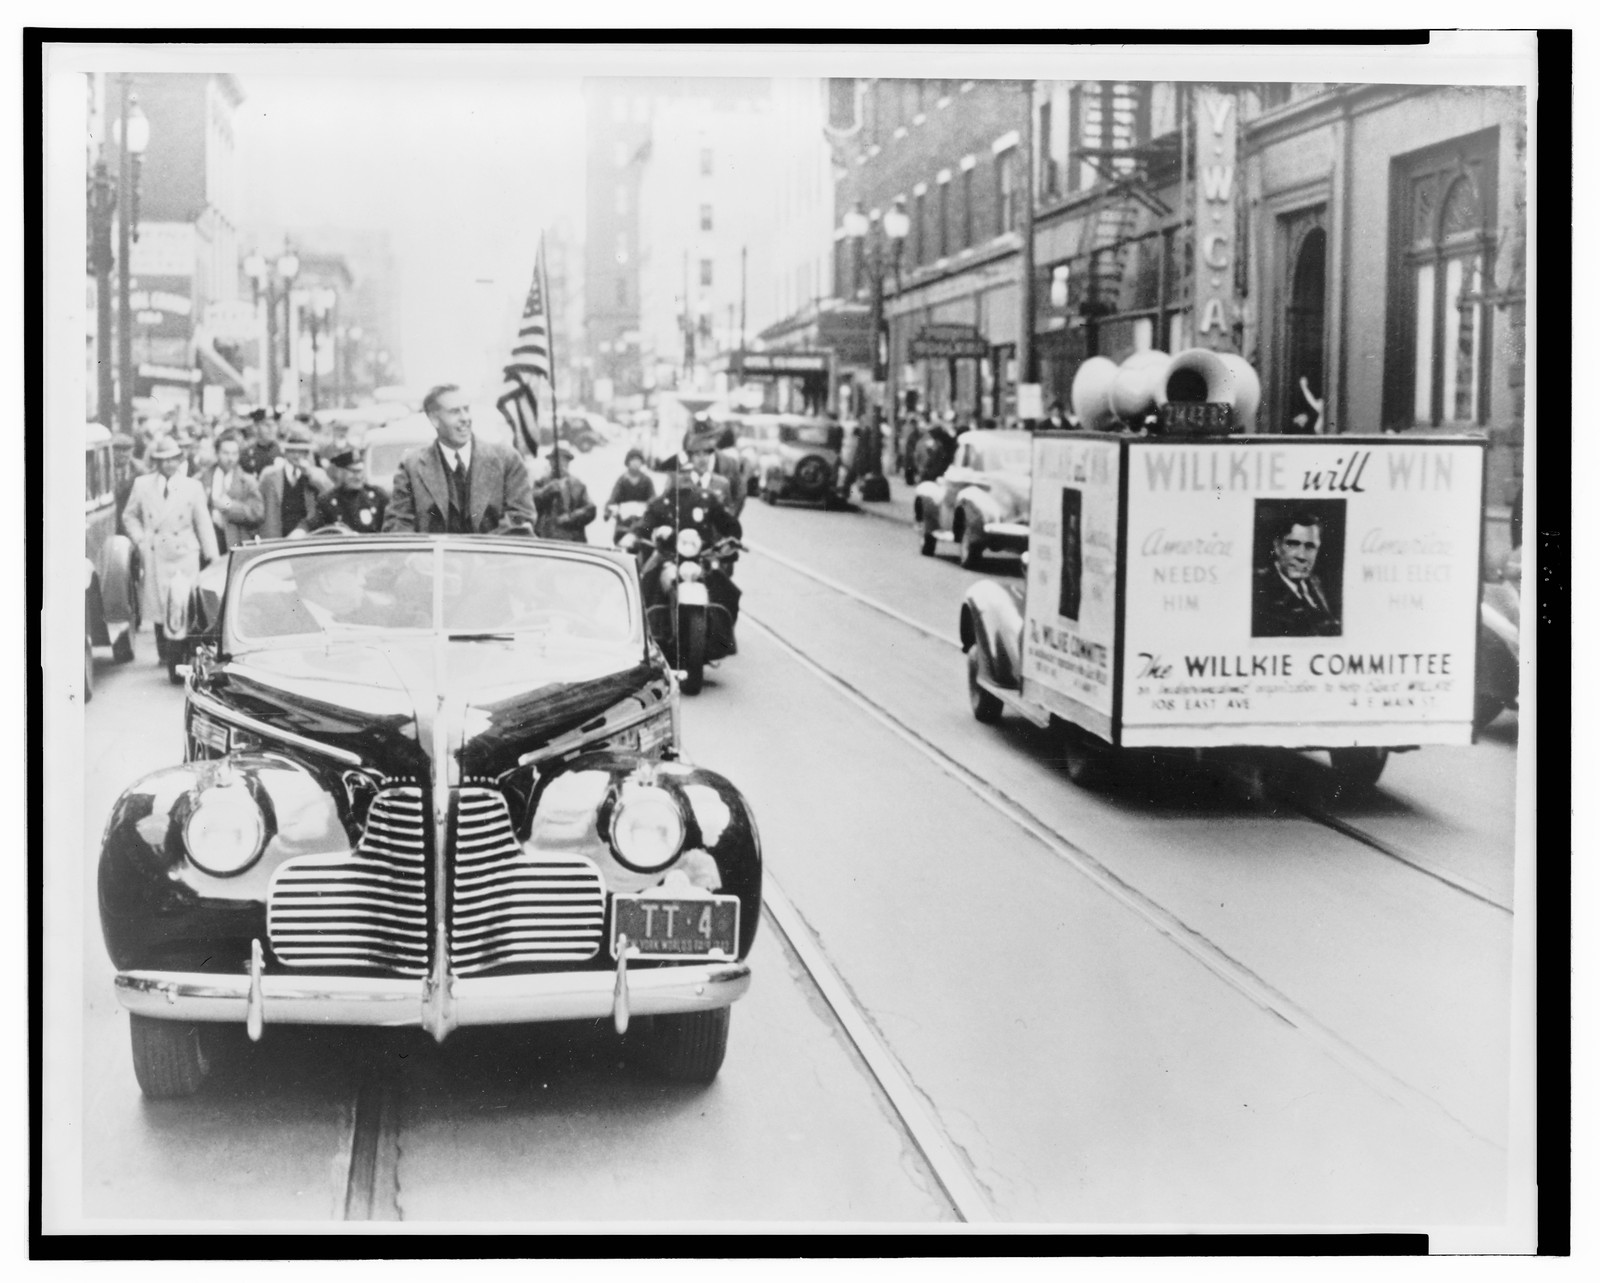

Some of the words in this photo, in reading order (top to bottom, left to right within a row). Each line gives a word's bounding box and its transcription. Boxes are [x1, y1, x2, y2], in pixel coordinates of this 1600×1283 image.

[1144, 450, 1287, 492] WILLKIE
[1302, 450, 1371, 493] will
[1387, 451, 1454, 492] WIN
[1141, 527, 1235, 557] America
[1153, 565, 1219, 584] NEEDS
[1362, 563, 1398, 583] WILL
[1406, 563, 1452, 583] ELECT
[1163, 594, 1200, 612] HIM
[1388, 593, 1424, 610] HIM
[1137, 652, 1174, 680] The
[1184, 653, 1293, 678] WILLKIE
[1309, 653, 1452, 677] COMMITTEE
[1185, 699, 1216, 710] EAST
[1383, 697, 1415, 708] MAIN
